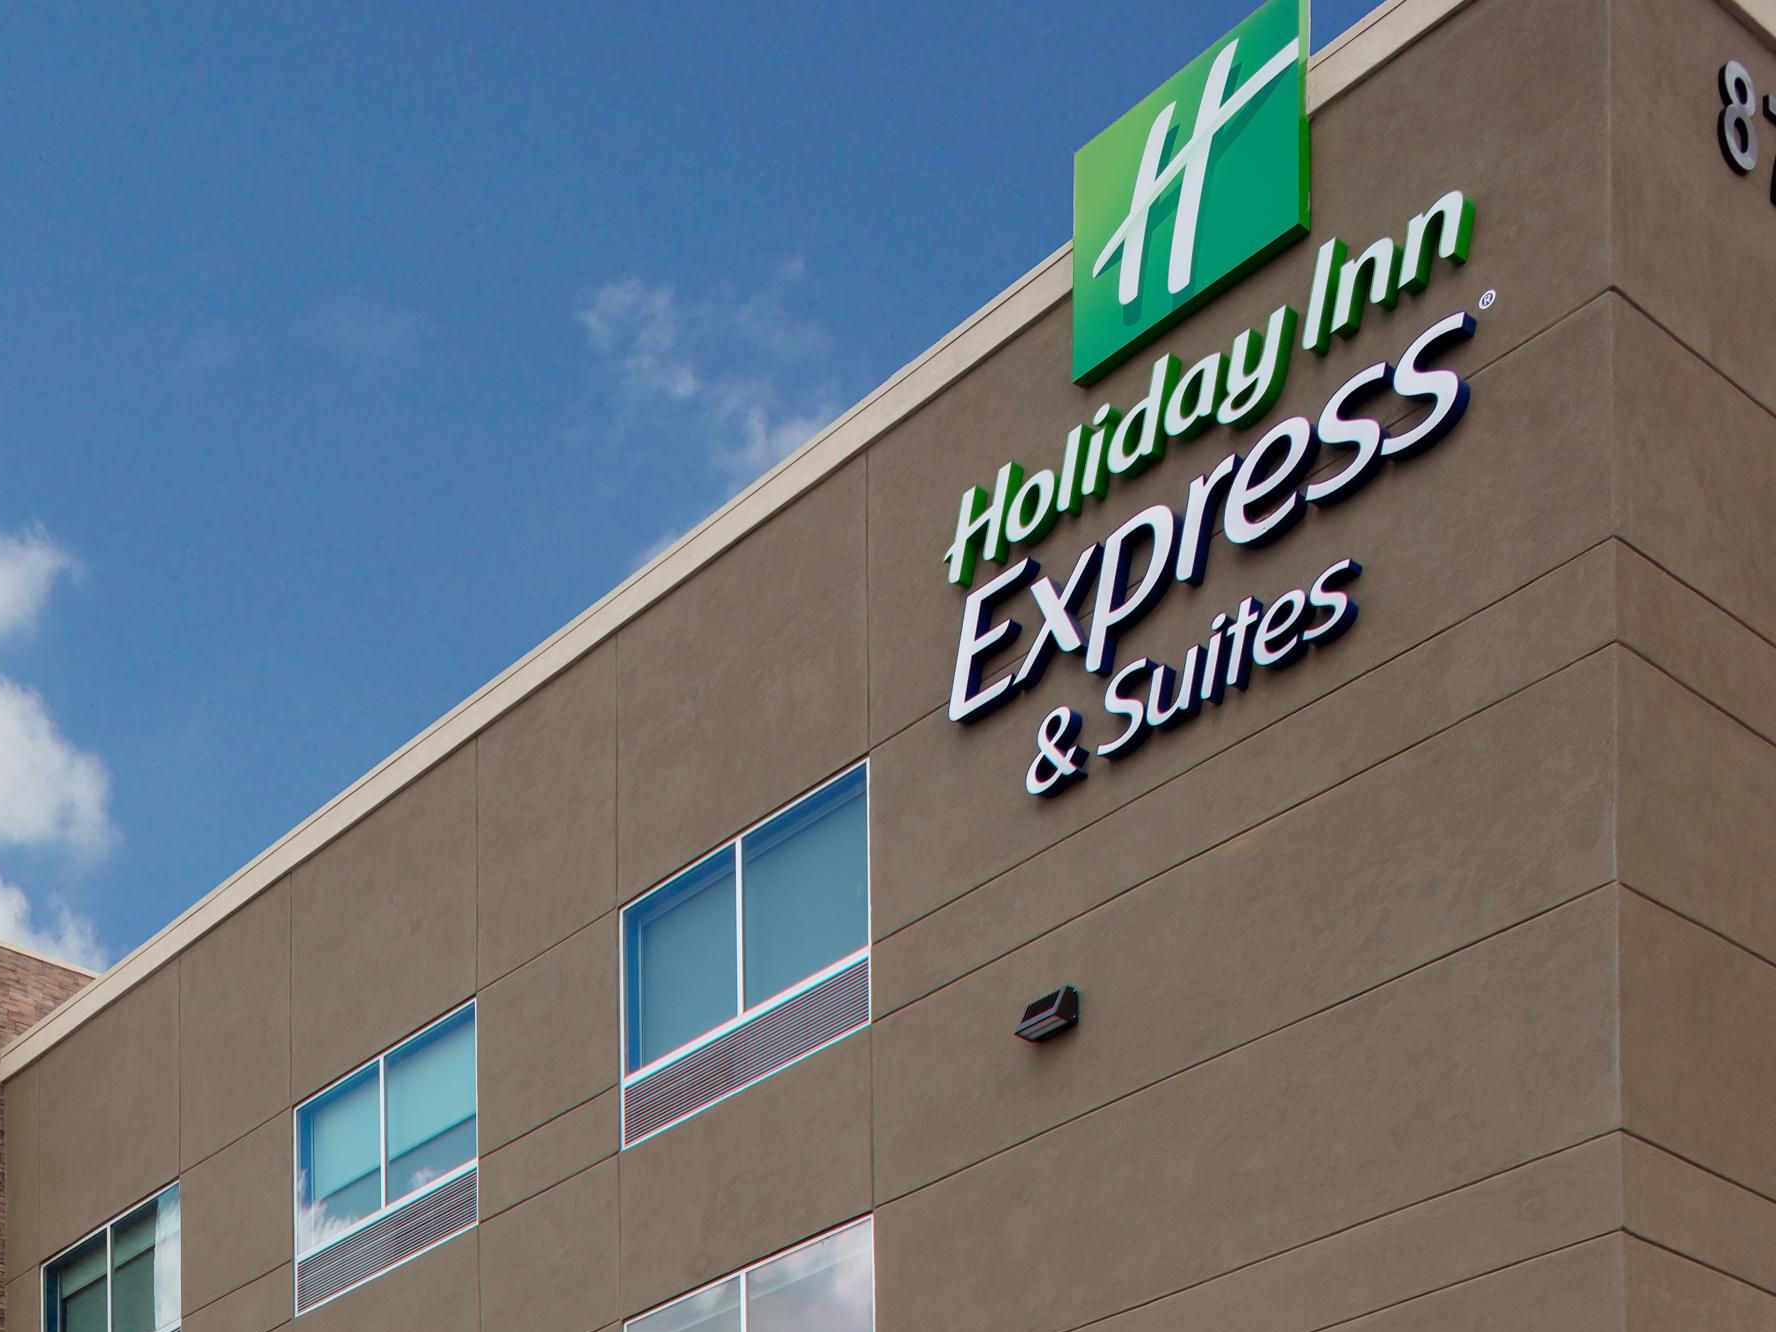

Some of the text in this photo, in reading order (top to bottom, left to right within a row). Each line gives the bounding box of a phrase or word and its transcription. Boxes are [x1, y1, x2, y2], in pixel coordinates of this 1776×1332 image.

[1718, 60, 1776, 208] 8
[944, 190, 1475, 586] Holiday Inn
[948, 311, 1476, 723] Express
[1026, 559, 1362, 798] & Suites
